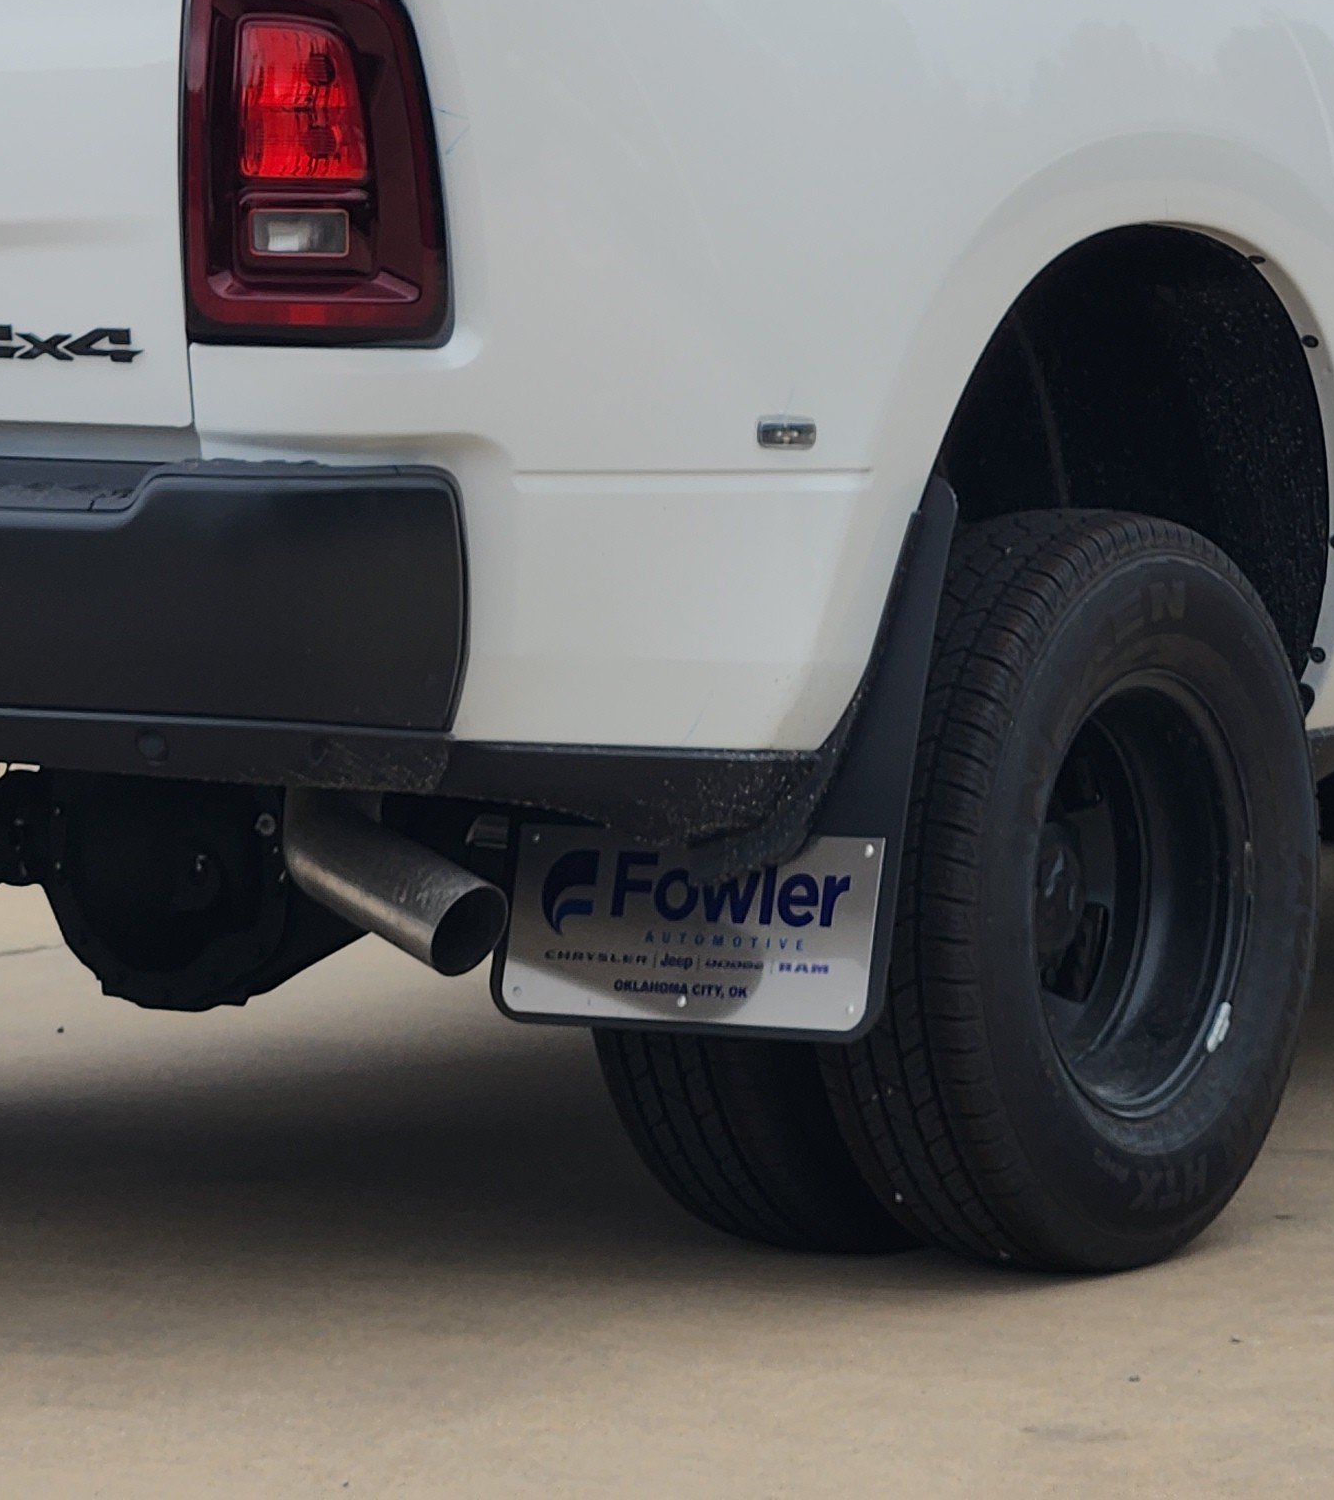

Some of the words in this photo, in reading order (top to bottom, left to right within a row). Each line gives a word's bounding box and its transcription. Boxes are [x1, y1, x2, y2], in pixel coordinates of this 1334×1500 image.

[609, 850, 852, 928] Fowler
[644, 930, 805, 952] AUTOMOTIVE
[544, 950, 648, 966] CHRYSLER
[659, 953, 694, 971] Jeep
[778, 961, 830, 975] RAM
[613, 977, 689, 995] OKLAHOMA
[728, 986, 748, 999] OK
